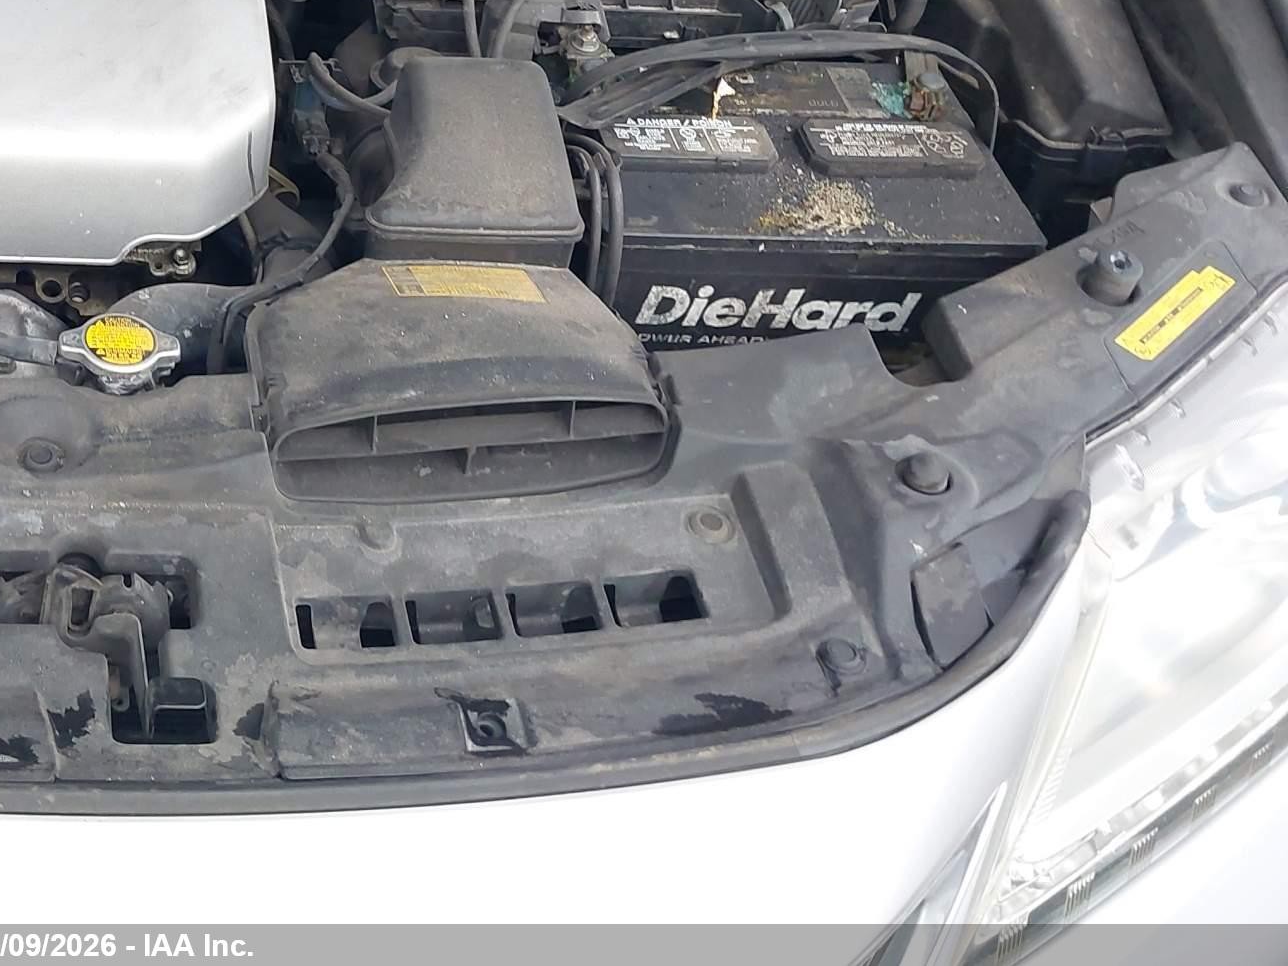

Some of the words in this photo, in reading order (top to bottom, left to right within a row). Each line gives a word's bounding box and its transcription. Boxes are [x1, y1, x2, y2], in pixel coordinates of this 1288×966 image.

[637, 118, 681, 128] DANGER
[635, 285, 923, 332] DieHard
[638, 332, 692, 344] OWER
